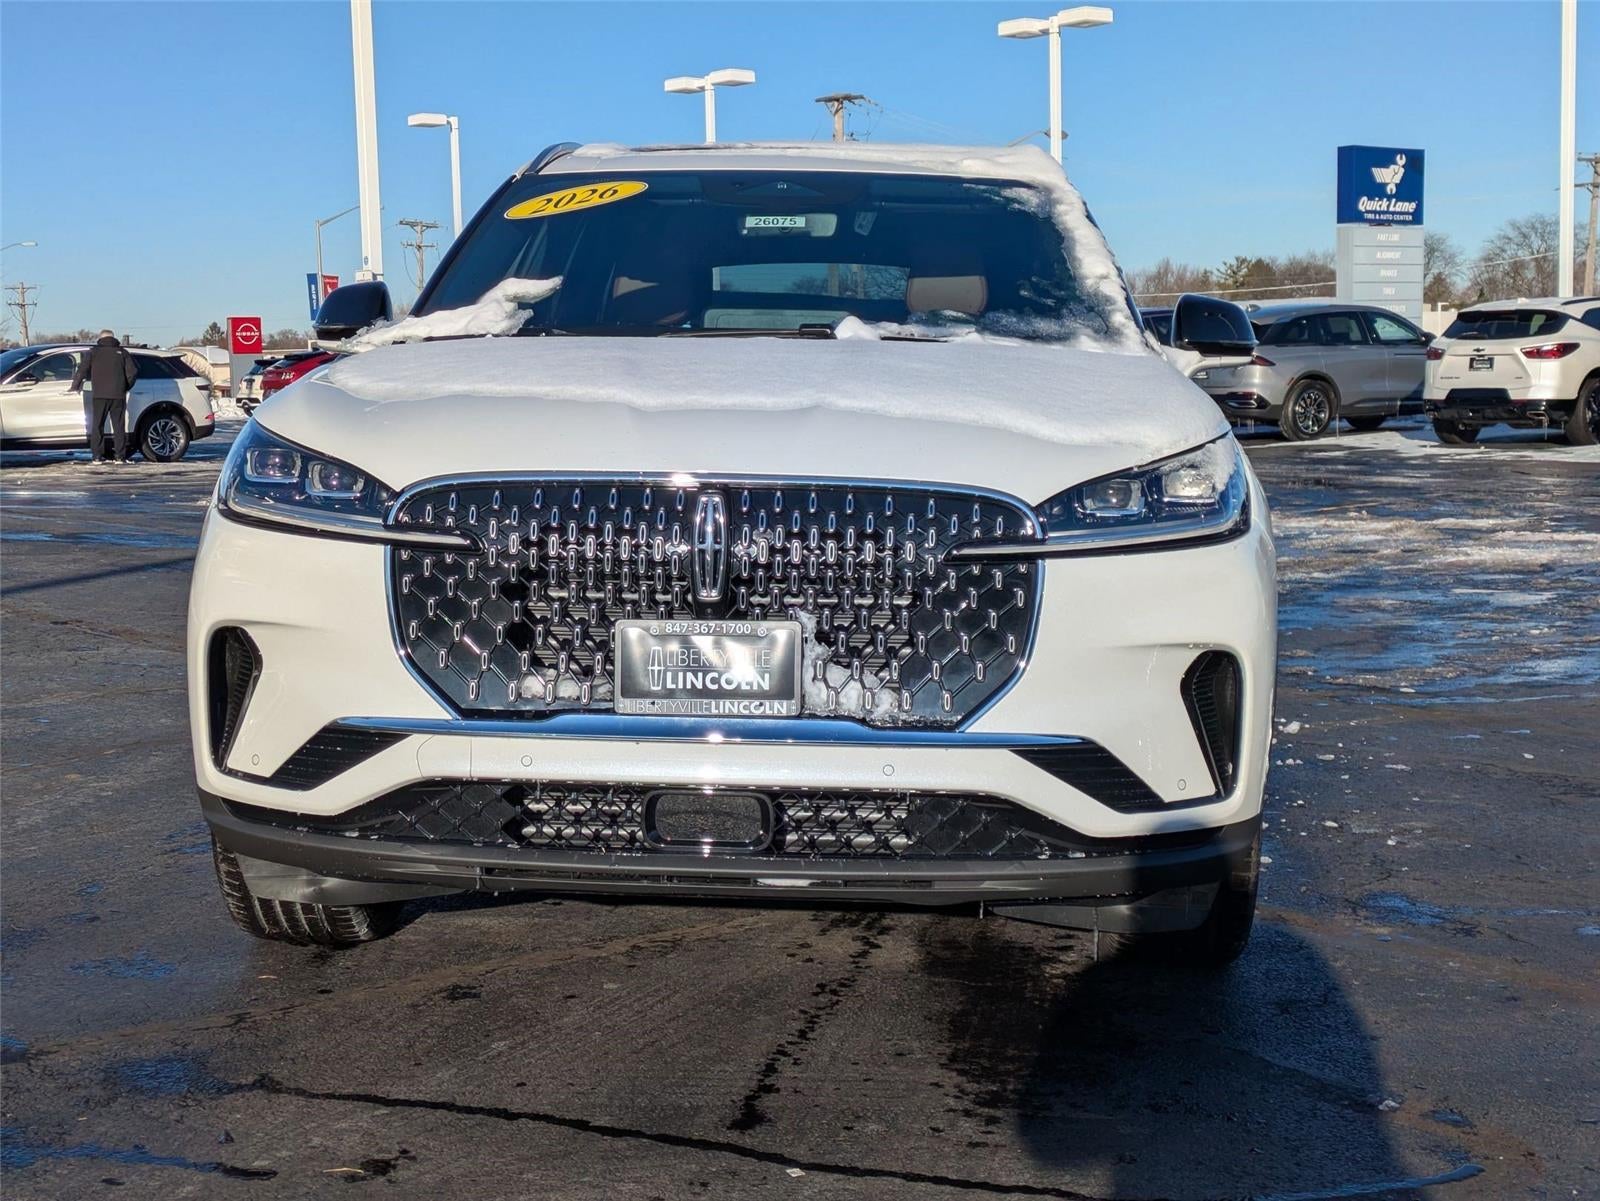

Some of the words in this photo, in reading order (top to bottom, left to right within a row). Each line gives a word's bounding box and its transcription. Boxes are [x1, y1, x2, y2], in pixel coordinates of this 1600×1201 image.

[529, 184, 620, 215] 2026
[1358, 196, 1389, 212] Quick
[1389, 198, 1416, 213] Lane
[754, 217, 798, 227] 26075
[665, 623, 751, 634] 847-367-1700
[666, 671, 770, 691] LINCOLN
